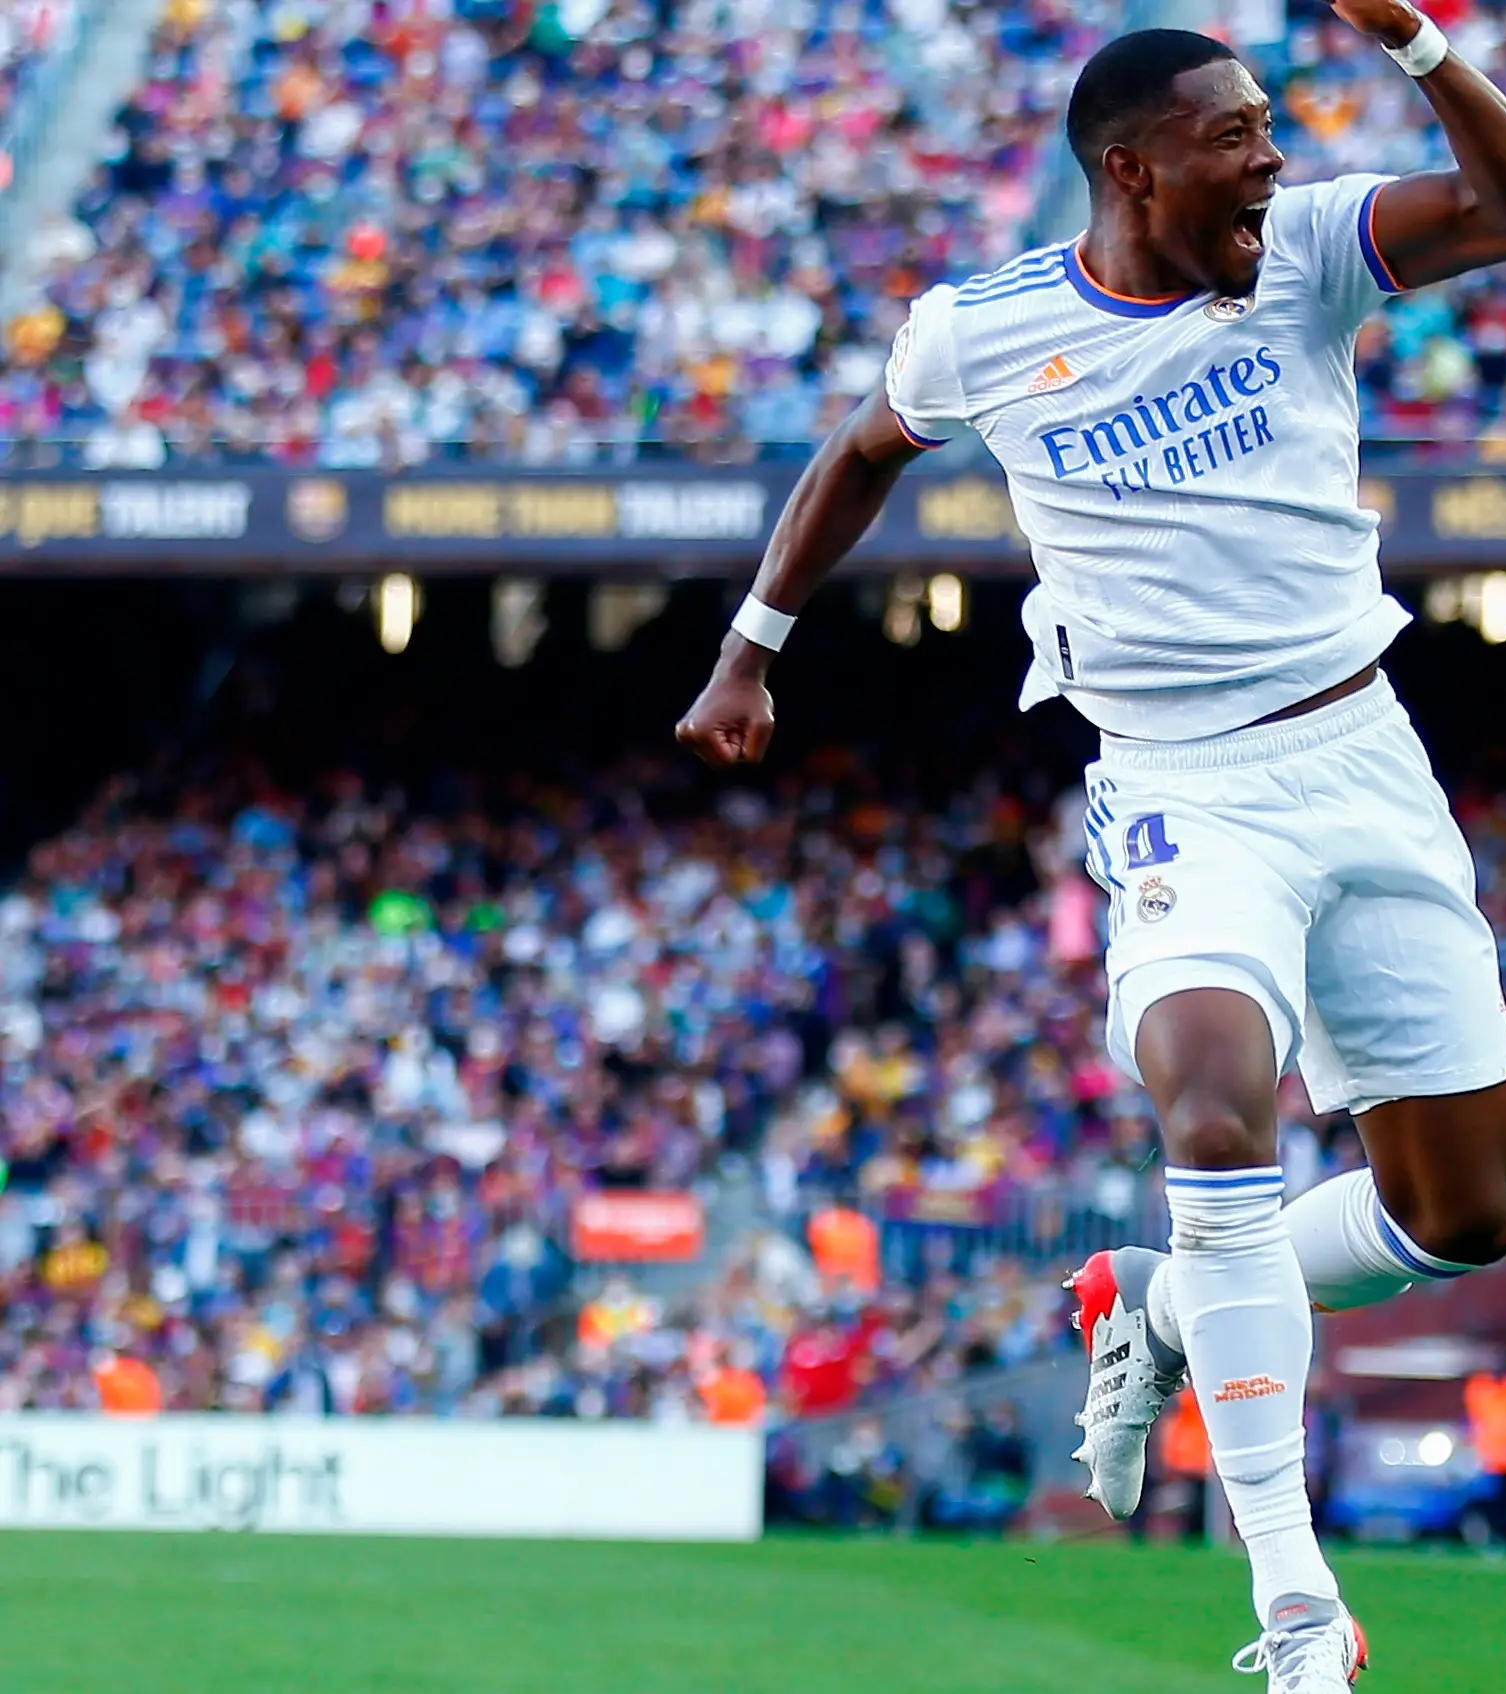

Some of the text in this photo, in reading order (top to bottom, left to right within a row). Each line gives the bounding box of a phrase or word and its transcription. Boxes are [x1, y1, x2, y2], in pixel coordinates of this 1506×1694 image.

[1027, 376, 1074, 394] adid
[1040, 346, 1281, 479] Emirates
[1101, 404, 1275, 501] FLY BETTER
[1213, 1382, 1286, 1403] MADRID
[141, 1437, 344, 1532] Light
